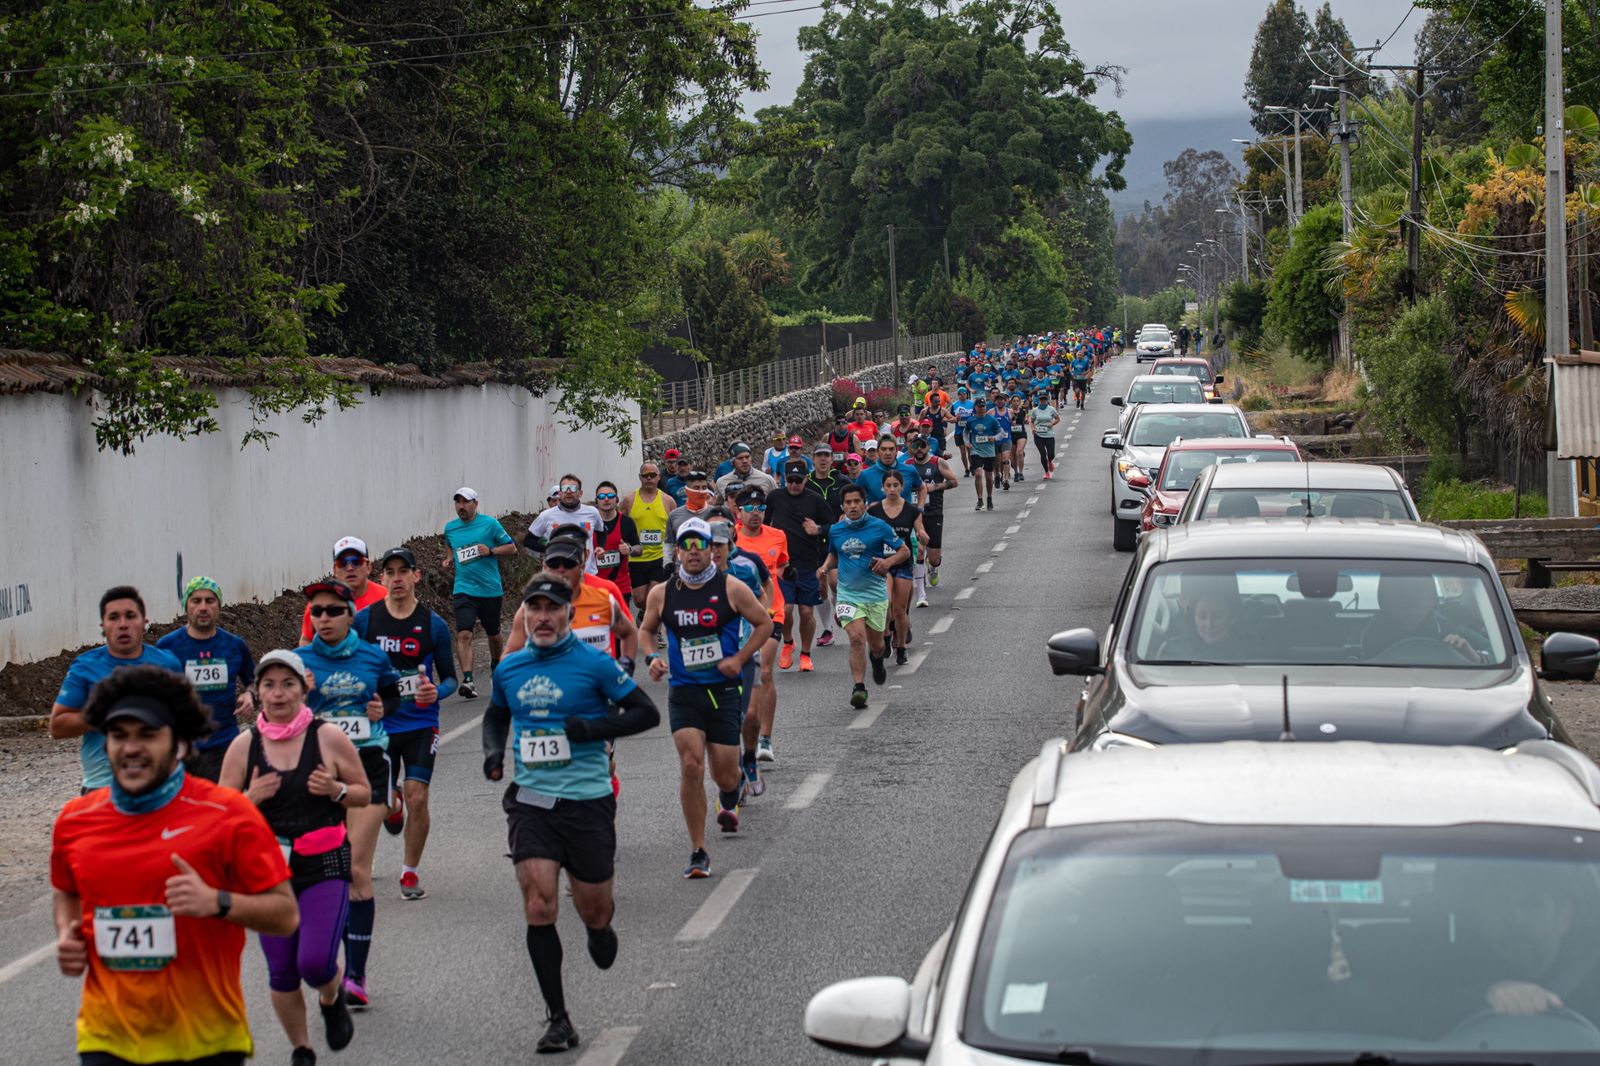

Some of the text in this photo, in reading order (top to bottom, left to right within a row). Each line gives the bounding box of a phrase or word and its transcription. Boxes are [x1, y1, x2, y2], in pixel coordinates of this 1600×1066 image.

[461, 548, 476, 559] 722
[689, 646, 715, 661] 775
[194, 667, 220, 681] 736
[398, 679, 412, 692] 51
[333, 721, 361, 735] 24
[528, 740, 559, 757] 713
[108, 925, 153, 949] 741
